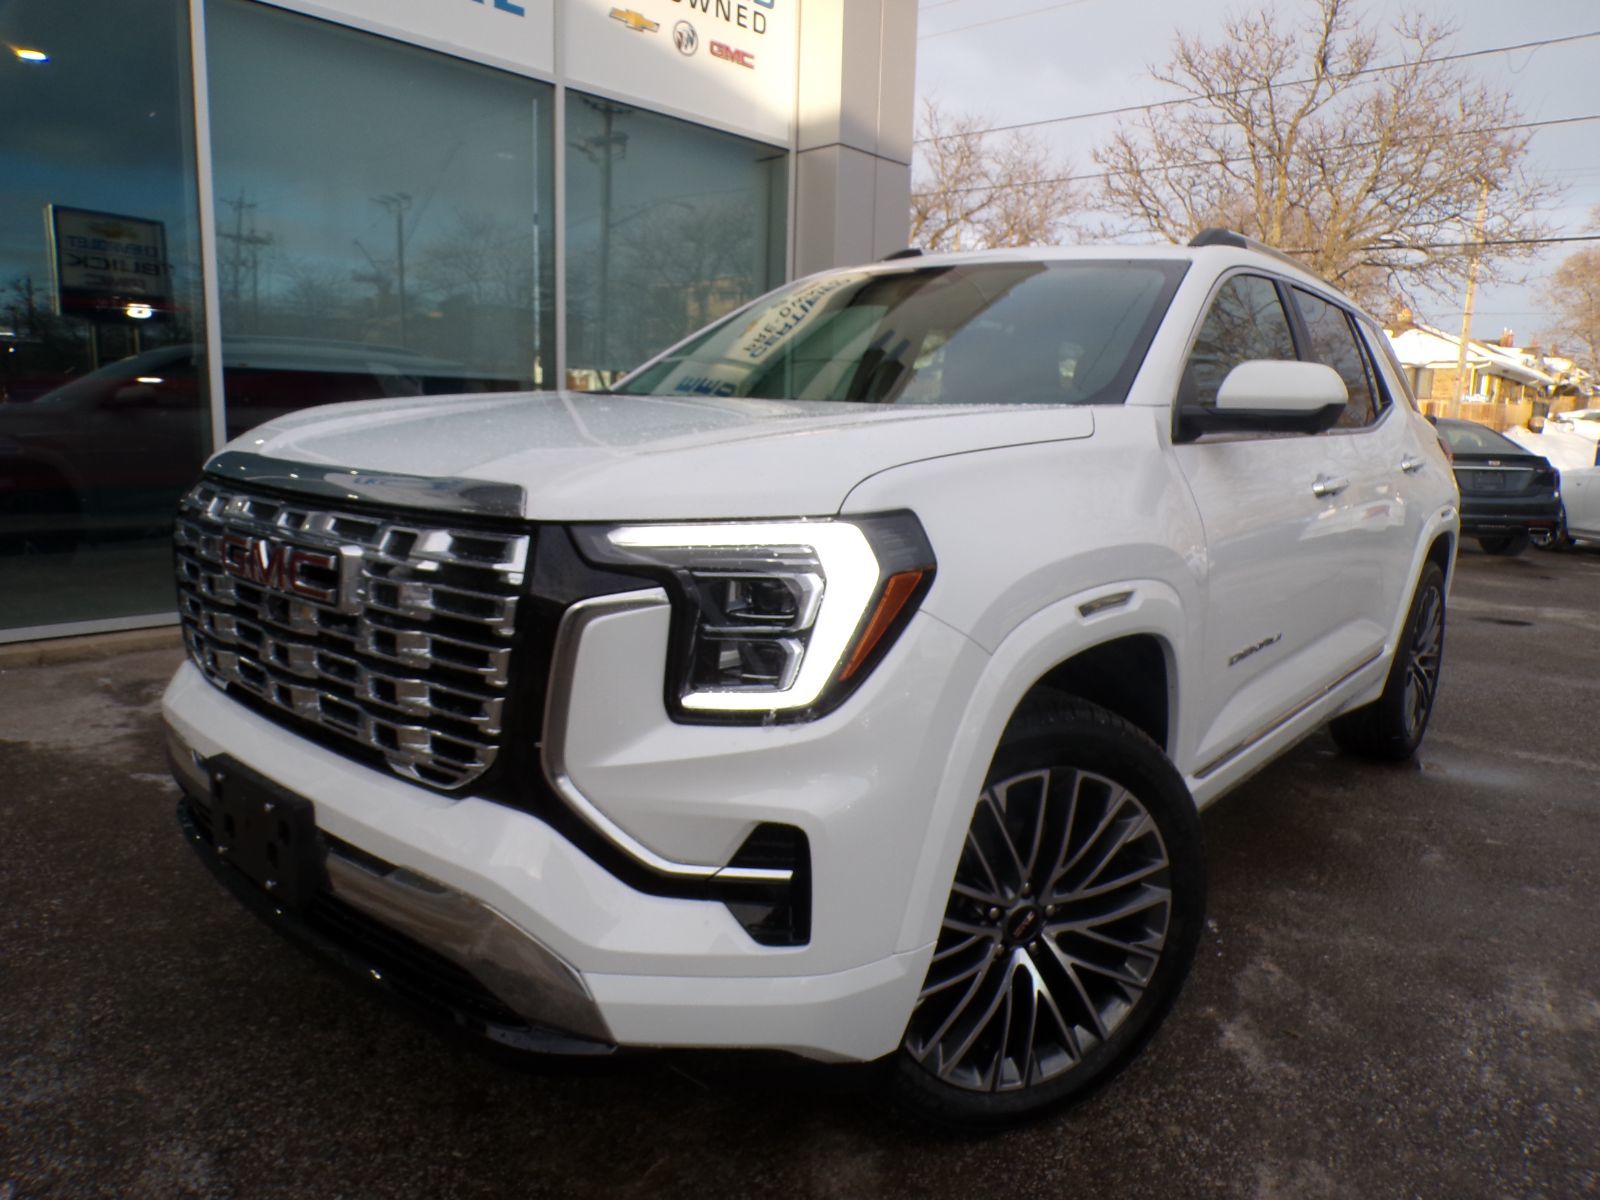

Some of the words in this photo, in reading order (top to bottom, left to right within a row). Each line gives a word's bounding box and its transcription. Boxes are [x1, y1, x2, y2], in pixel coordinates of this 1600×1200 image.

[671, 0, 767, 35] WNED
[708, 40, 755, 70] GMC
[222, 533, 338, 603] GMC
